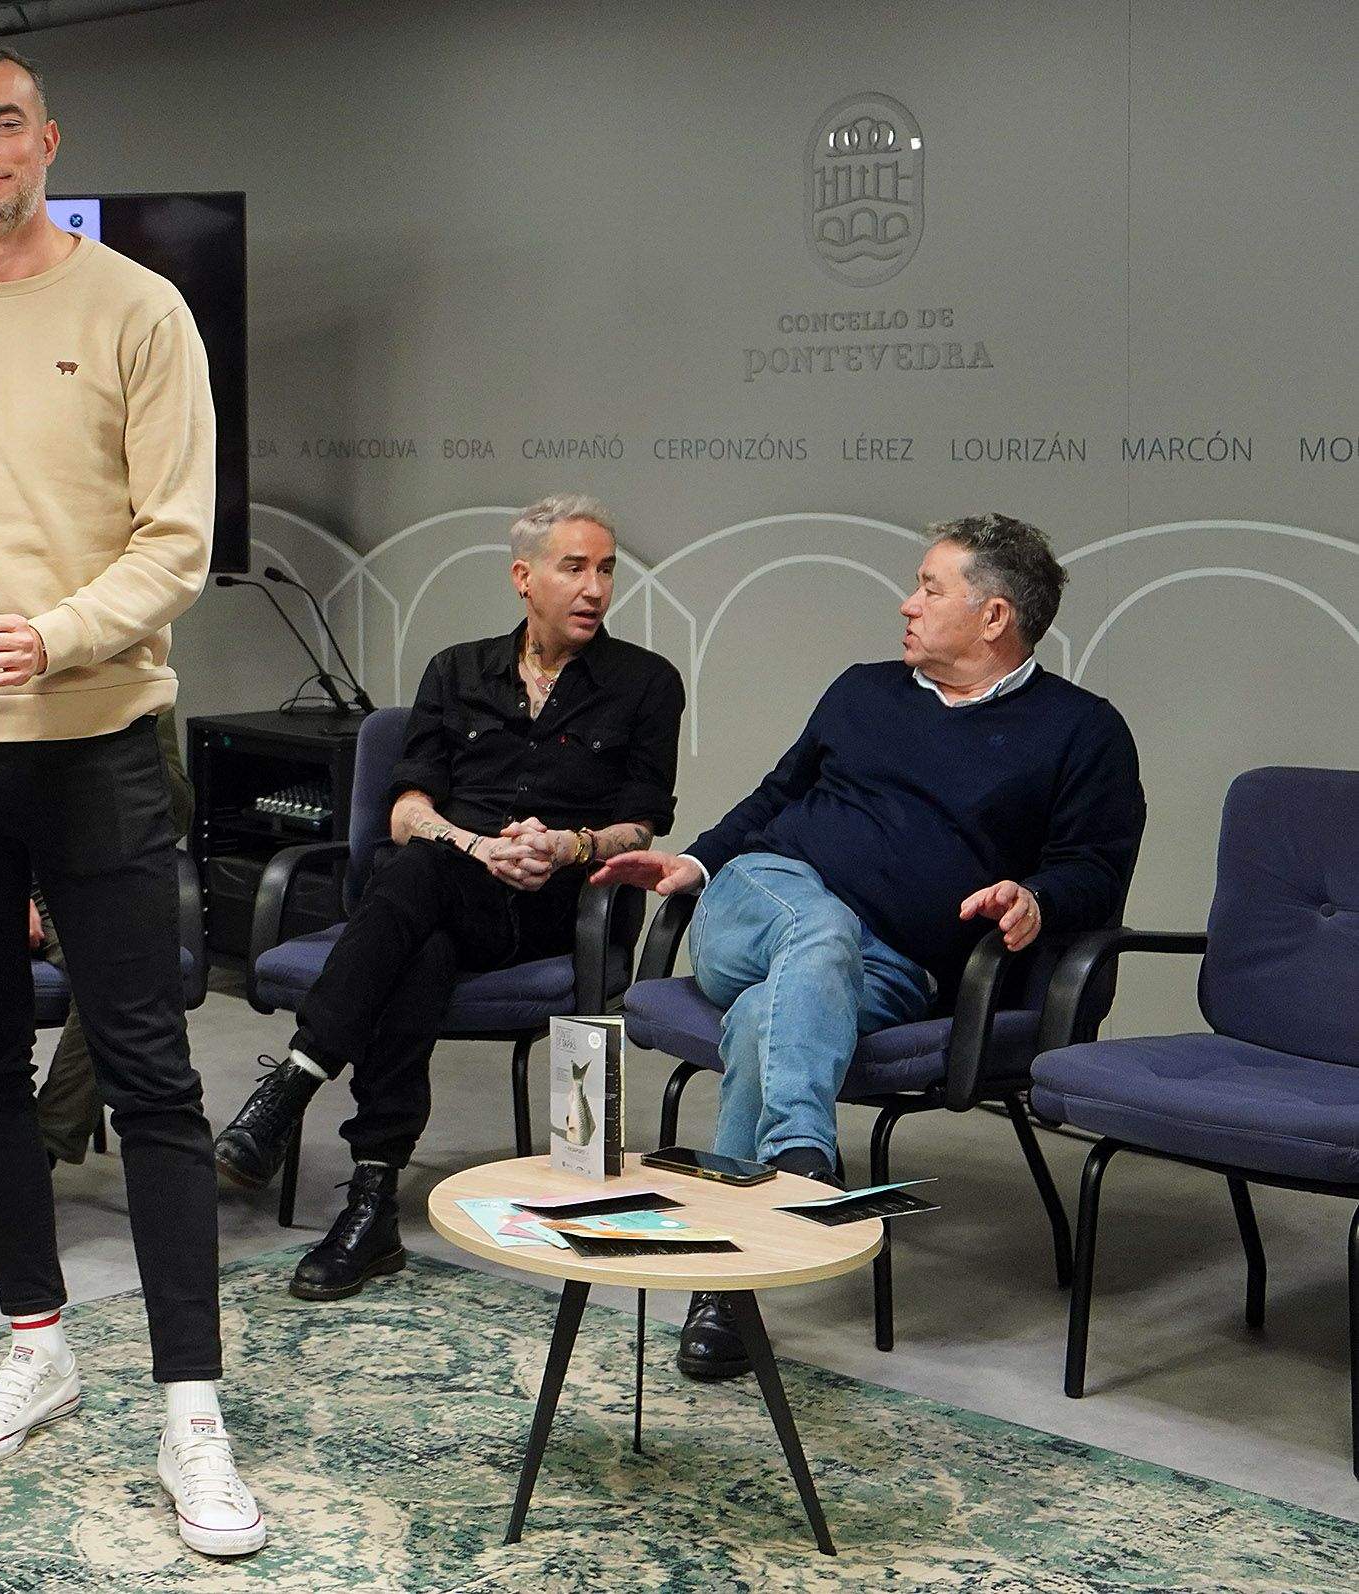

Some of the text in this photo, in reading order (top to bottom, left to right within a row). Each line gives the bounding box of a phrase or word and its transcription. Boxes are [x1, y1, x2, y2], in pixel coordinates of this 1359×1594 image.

[778, 307, 954, 334] CONCELLO DE
[249, 430, 1359, 463] BA A CANICOUVA BORA CAMPAÑÓ CERPONZÓNS LÉREZ LOURIZÁN MARCÓN MO
